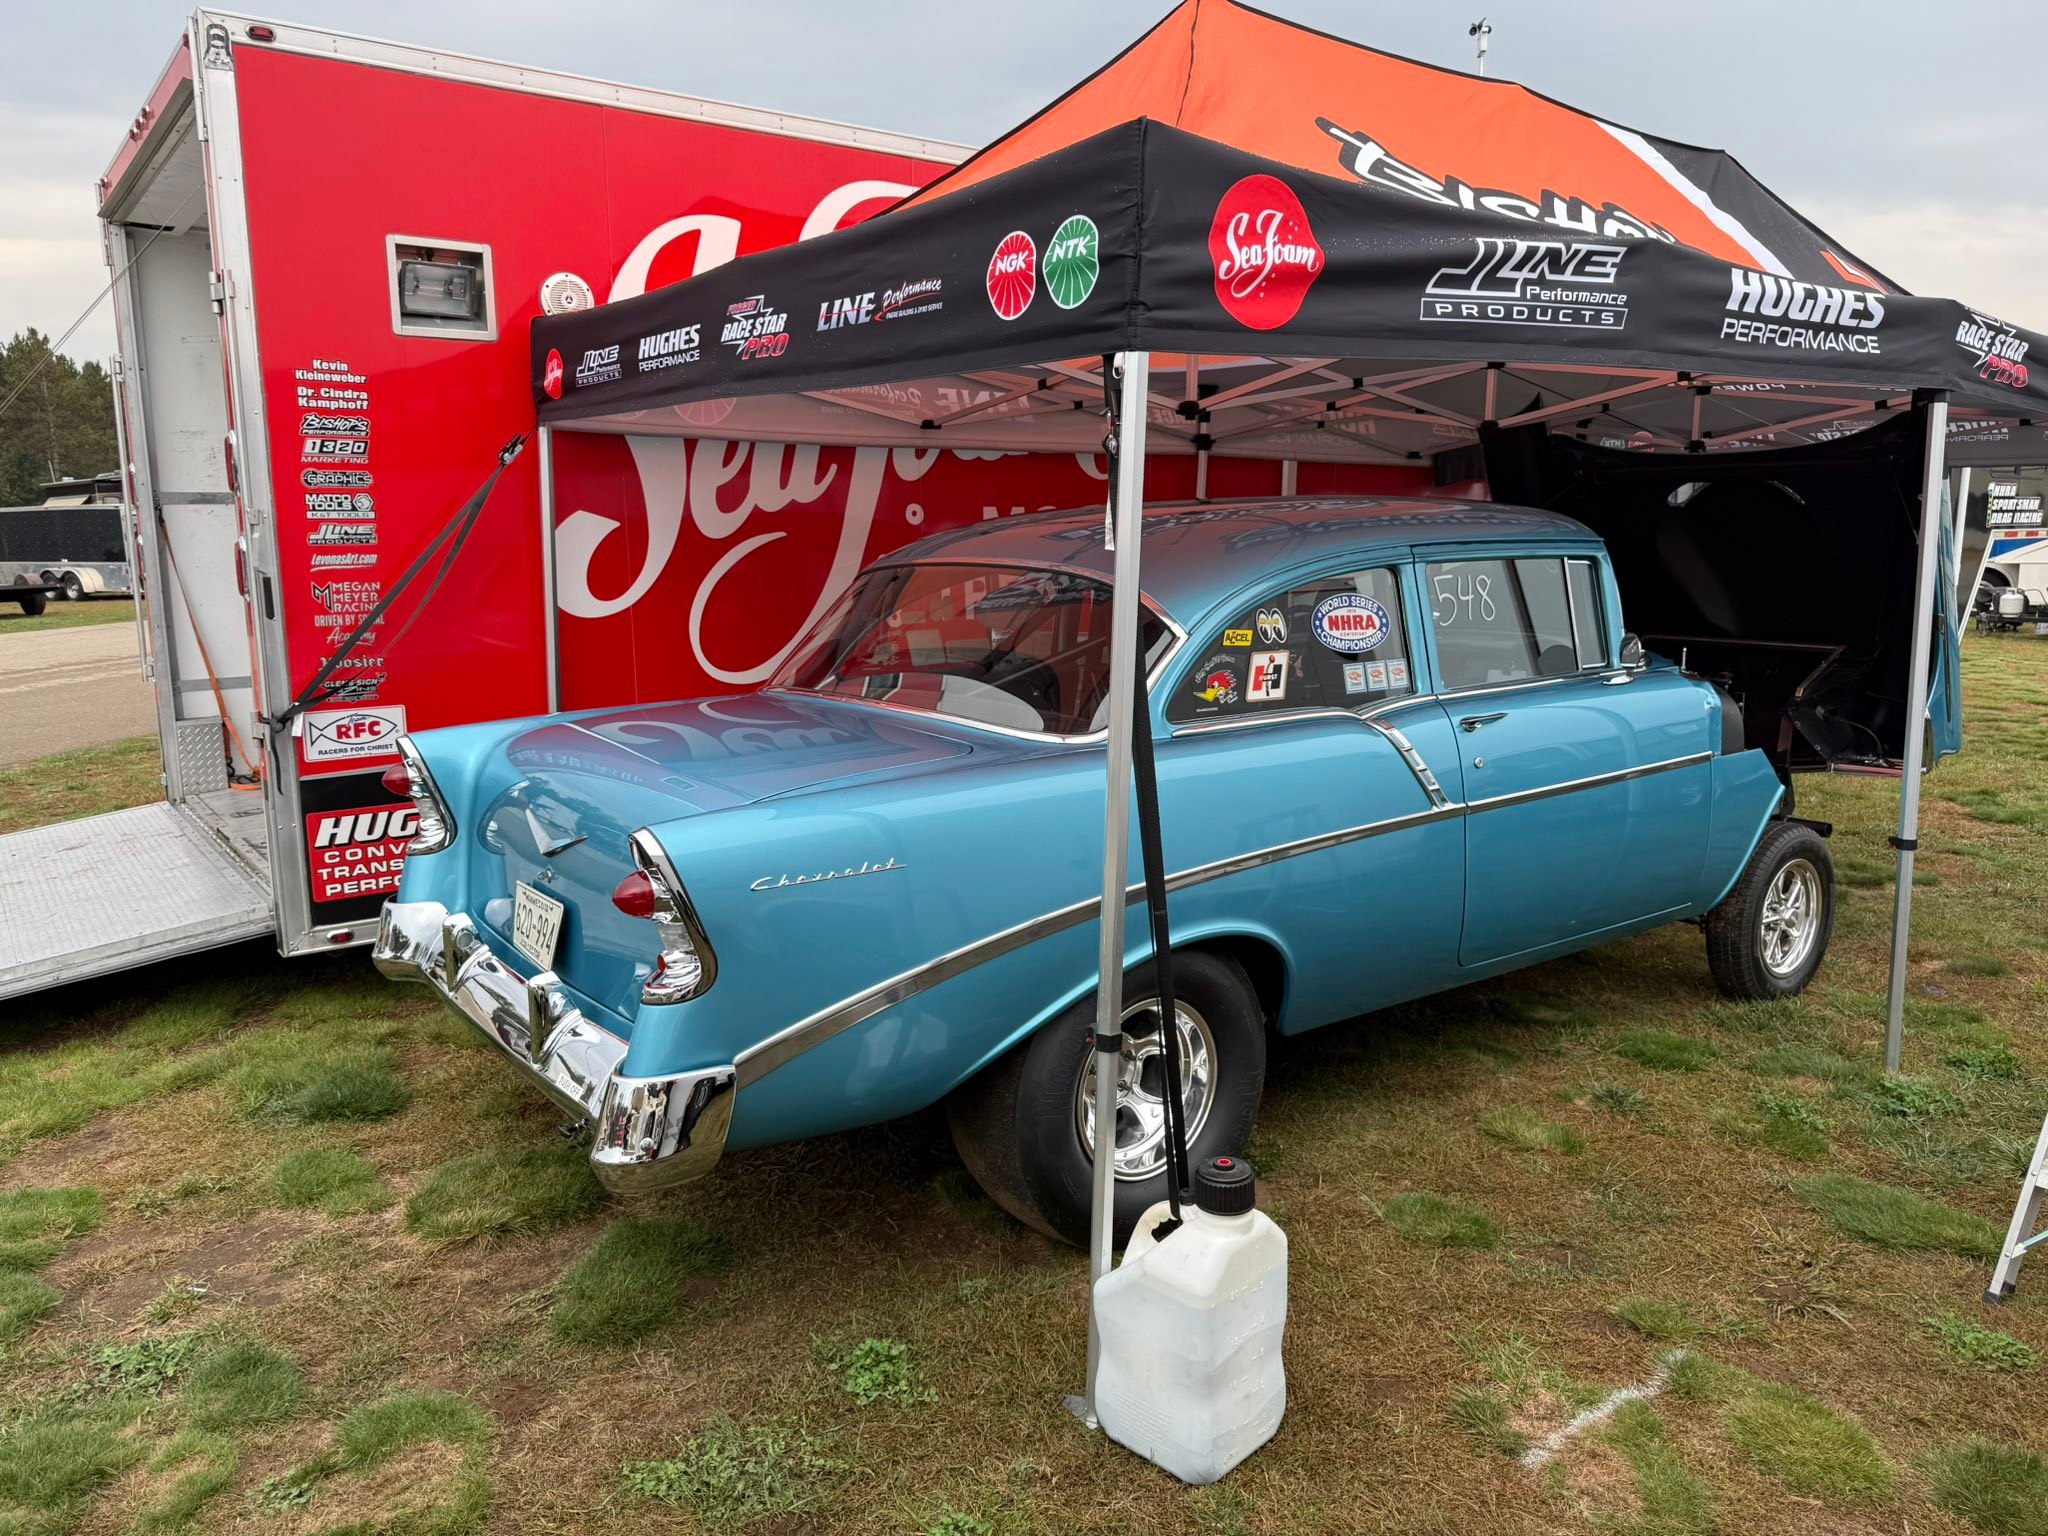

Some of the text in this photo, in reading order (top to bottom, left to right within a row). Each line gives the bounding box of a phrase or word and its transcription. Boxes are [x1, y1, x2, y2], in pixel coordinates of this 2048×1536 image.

[1052, 234, 1091, 262] NTK
[994, 250, 1030, 276] NGK
[1526, 286, 1627, 305] Performance
[1725, 267, 1886, 329] HUGHES
[816, 277, 943, 332] LINE Performance
[1435, 303, 1615, 325] PRODUCTS
[720, 313, 788, 343] RACE STAR
[1721, 317, 1881, 354] PERFORMANCE
[638, 324, 701, 360] HUGHES
[741, 332, 790, 360] PRO
[1955, 320, 2029, 363] RACE STAR
[312, 359, 348, 371] Kevin
[639, 350, 700, 372] PERFORMANCE
[295, 369, 367, 384] Kleineweber
[578, 371, 619, 385] PRODUCTS
[1980, 355, 2028, 388] PRO
[297, 386, 368, 399] Dr. Cindra
[298, 397, 368, 410] Kamphoff
[302, 414, 369, 431] BISHOP'S
[301, 429, 368, 437] PERFORMANCE
[304, 440, 369, 454] 1320
[301, 456, 369, 464] MARKETING
[305, 494, 351, 503] MATCO
[1993, 485, 2017, 497] NHRA
[306, 502, 352, 511] TOOLS
[1992, 498, 2040, 511] SPORTSMAN
[1991, 512, 2043, 524] DRAG RACING
[332, 582, 380, 592] MEGAN
[333, 592, 378, 602] MEYER
[1319, 596, 1378, 615] WORLD SERIES
[1433, 573, 1496, 626] 548
[314, 615, 343, 627] DRIVEN
[345, 614, 356, 625] BY
[1327, 614, 1377, 631] NHRA
[1225, 631, 1250, 644] ACCEL
[1320, 631, 1383, 650] CHAMPIONSHIP
[336, 720, 381, 740] RFC
[318, 748, 348, 756] RACERS
[367, 743, 393, 751] CHRIST
[750, 857, 907, 891] Chevrolet
